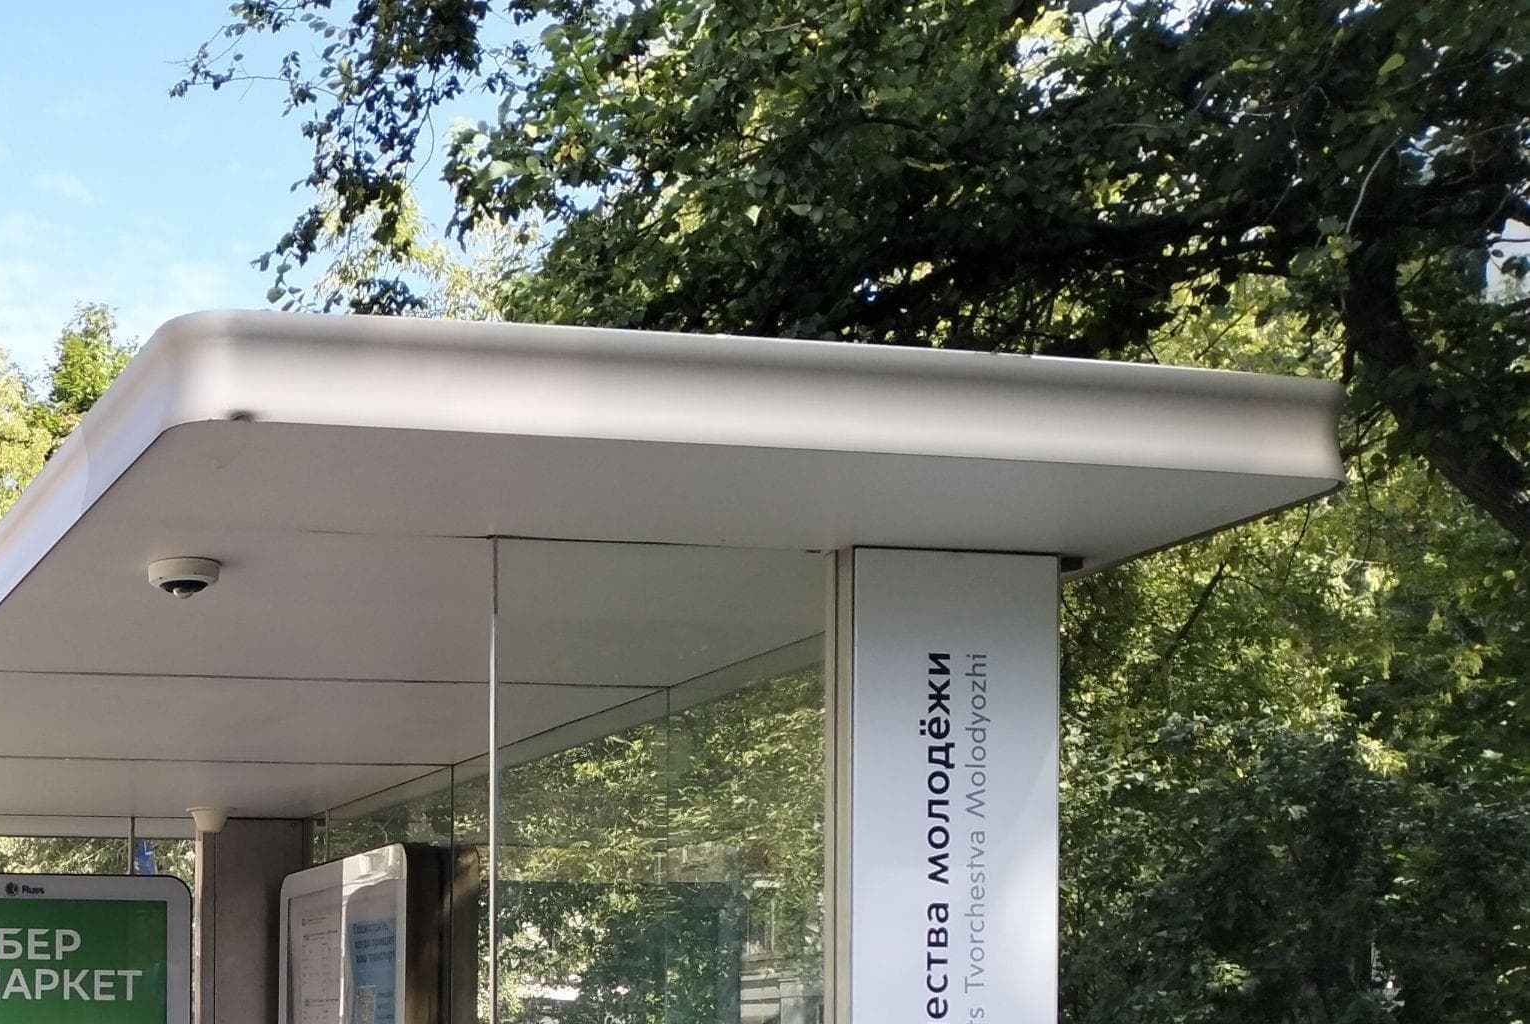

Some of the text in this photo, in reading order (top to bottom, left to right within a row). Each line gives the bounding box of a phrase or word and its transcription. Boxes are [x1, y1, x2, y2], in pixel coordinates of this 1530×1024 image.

[919, 652, 955, 885] молодёжи
[963, 652, 990, 820] Molodyozhi
[963, 830, 986, 993] Tvorchestva
